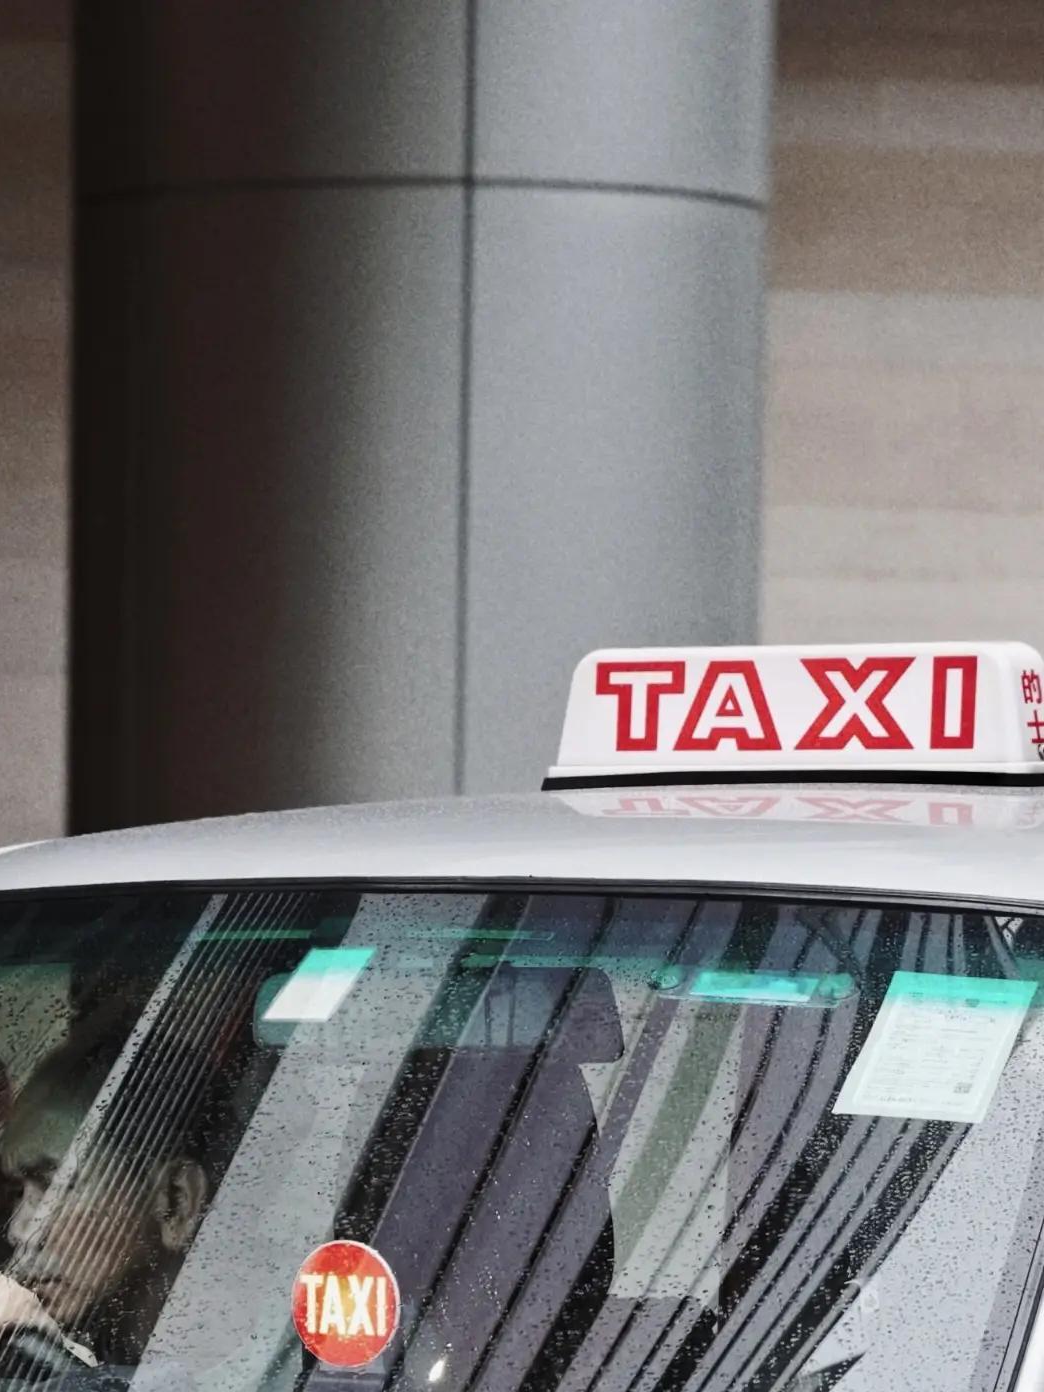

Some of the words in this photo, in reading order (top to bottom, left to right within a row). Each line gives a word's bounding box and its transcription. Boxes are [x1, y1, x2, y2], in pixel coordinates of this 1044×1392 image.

[596, 656, 978, 751] TAXI
[1021, 669, 1044, 744] 的士
[299, 1272, 387, 1337] TAXI
